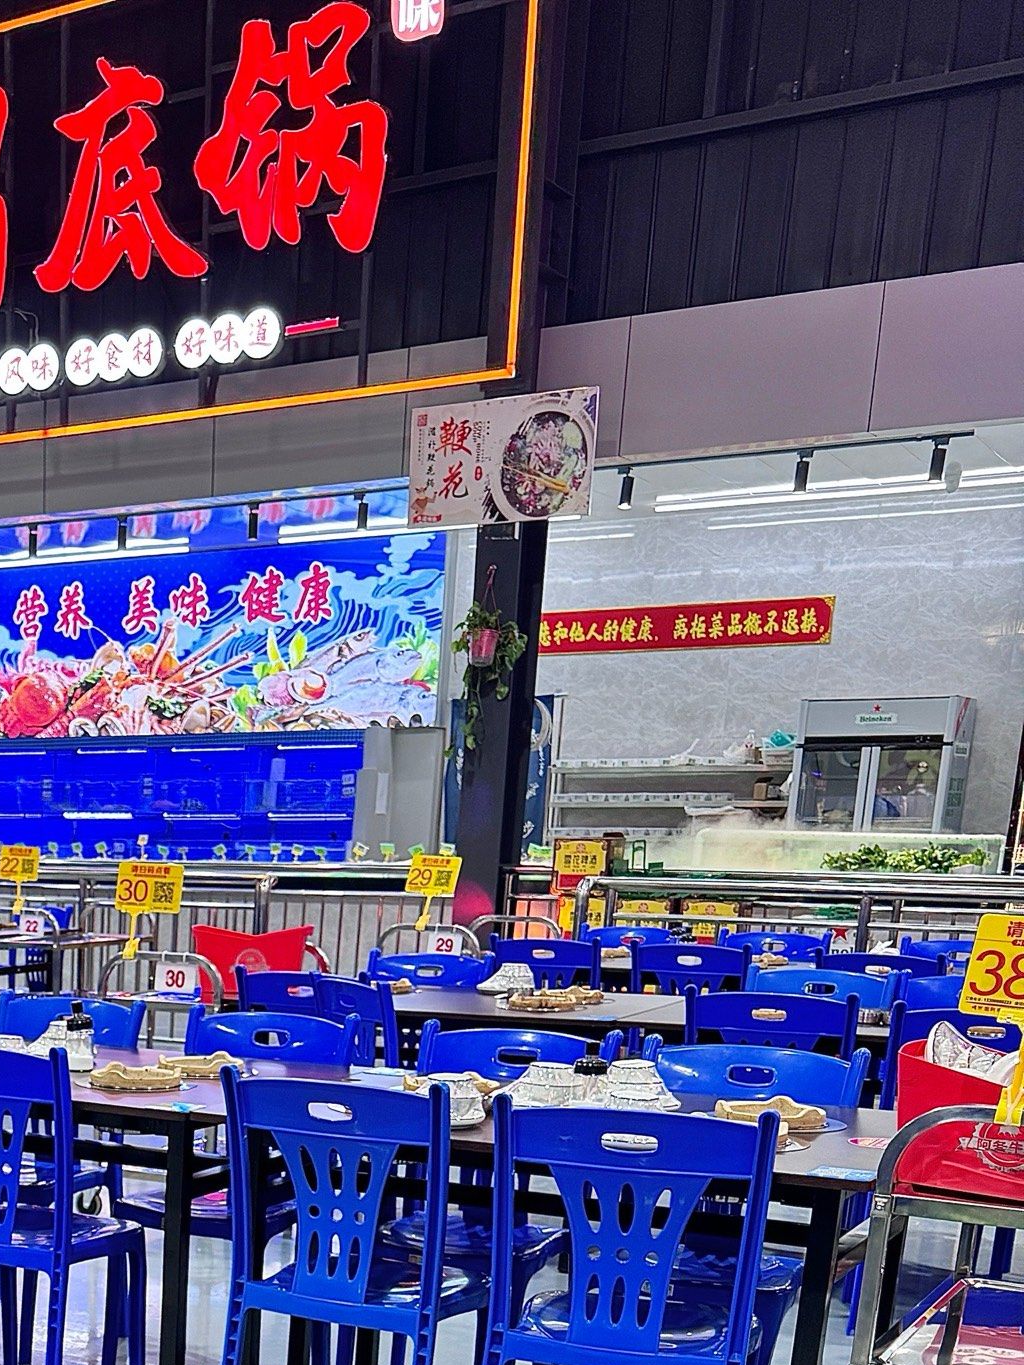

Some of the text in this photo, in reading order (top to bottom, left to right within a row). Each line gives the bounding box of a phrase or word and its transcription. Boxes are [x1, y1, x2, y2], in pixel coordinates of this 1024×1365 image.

[71, 336, 154, 375] 好食材
[181, 313, 271, 357] 好味道
[435, 417, 472, 499] 鞭花
[14, 583, 90, 640] 营养
[125, 572, 208, 634] 美味
[242, 562, 333, 625] 健康
[0, 857, 19, 873] 22
[408, 868, 432, 886] 29
[118, 879, 148, 902] 30
[25, 920, 38, 932] 22
[435, 938, 453, 952] 29
[165, 970, 185, 988] 30
[969, 949, 1024, 999] 38
